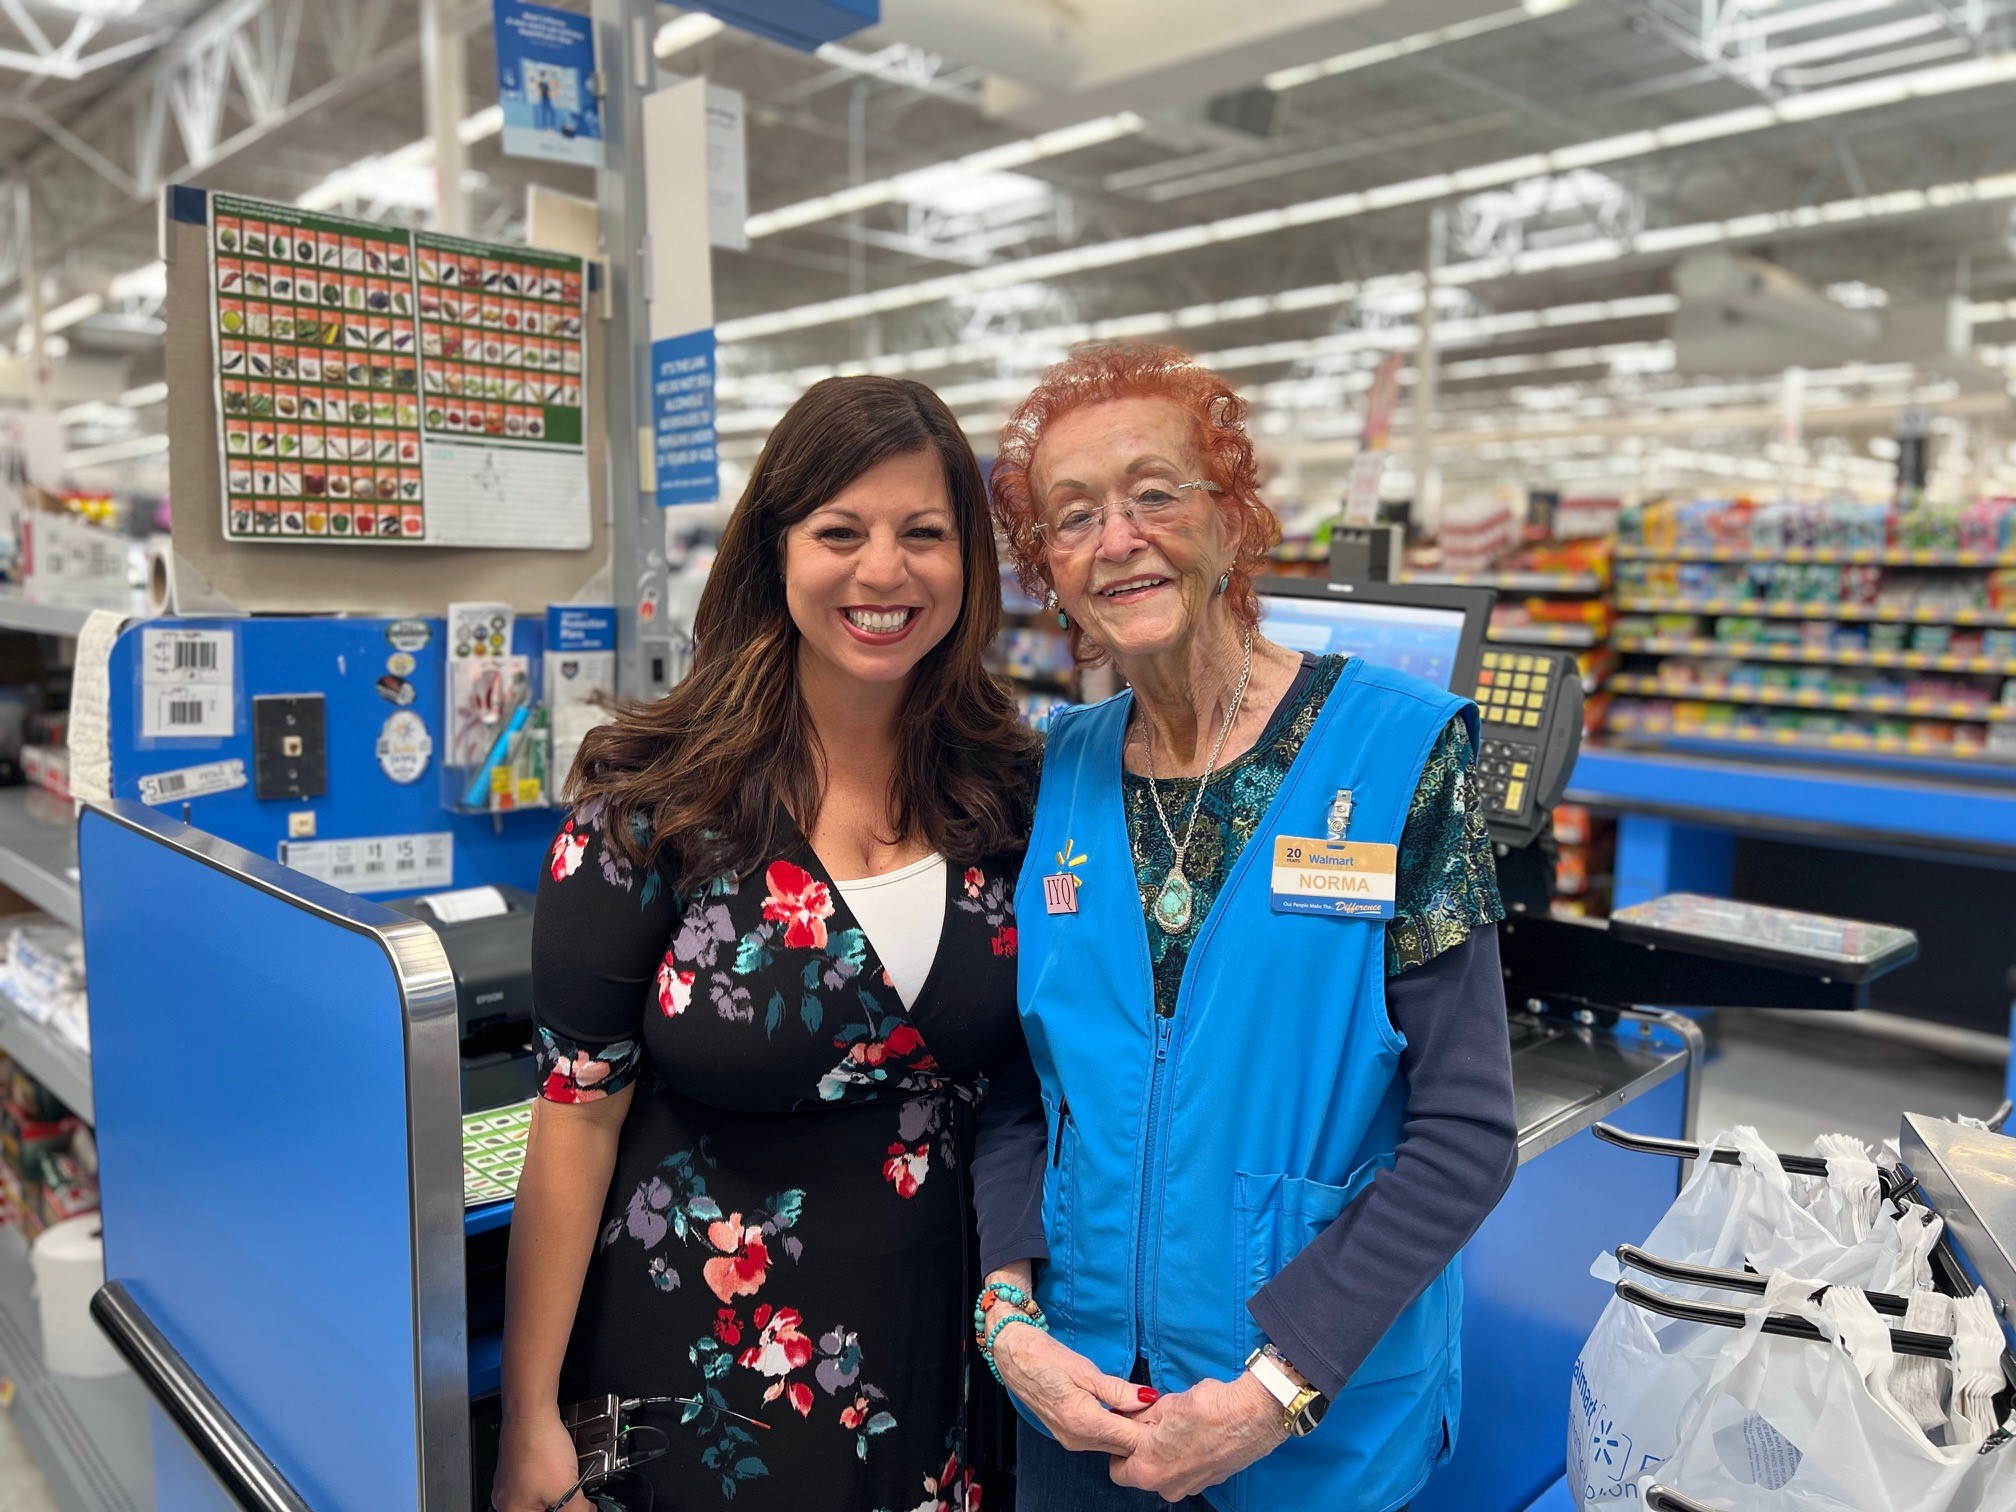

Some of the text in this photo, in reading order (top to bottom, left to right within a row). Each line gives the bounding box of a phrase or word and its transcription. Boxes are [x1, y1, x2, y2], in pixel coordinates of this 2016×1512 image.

[1286, 847, 1302, 859] 20
[1309, 854, 1354, 866] Walmart
[1299, 873, 1370, 893] NORMA
[1047, 878, 1073, 911] IYQ
[1335, 901, 1382, 914] Difference
[476, 992, 504, 1005] EPSON
[1573, 1358, 1598, 1427] almart
